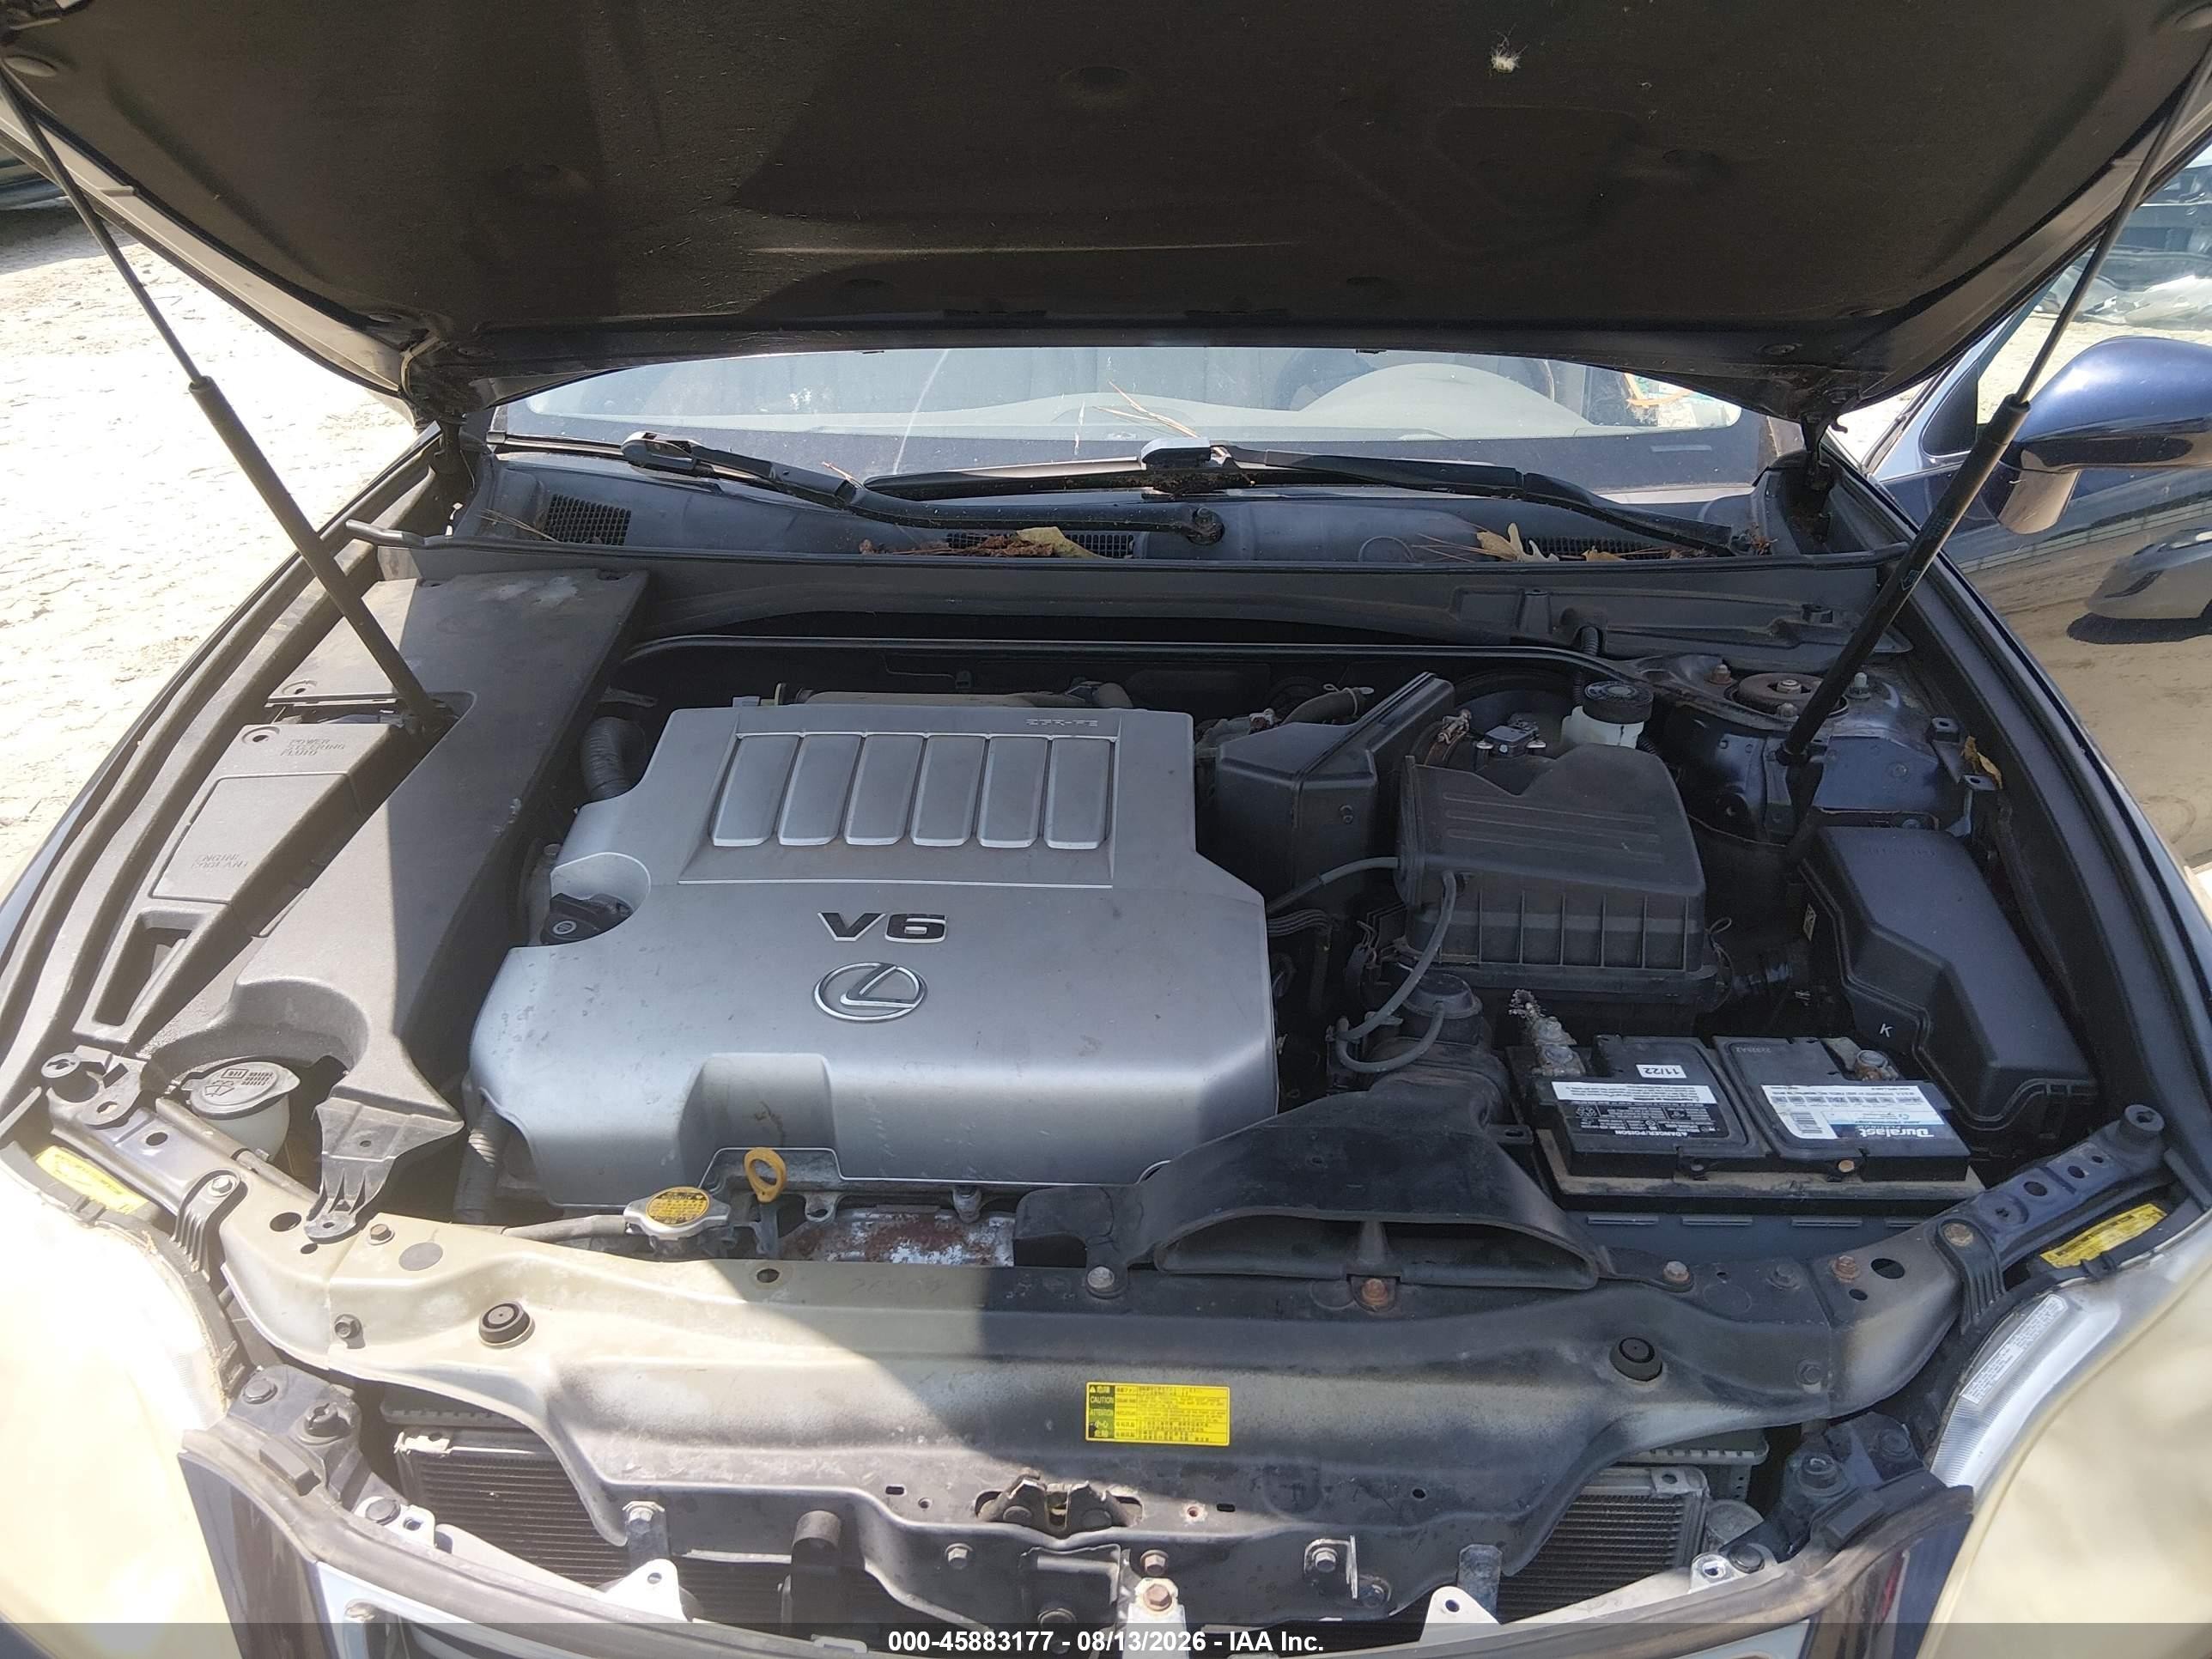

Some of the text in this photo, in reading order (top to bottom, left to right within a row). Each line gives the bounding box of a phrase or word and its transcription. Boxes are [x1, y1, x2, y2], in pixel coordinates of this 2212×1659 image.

[280, 748, 318, 757] FLUID
[817, 912, 949, 944] V6
[1880, 1023, 1893, 1038] K
[1643, 1067, 1680, 1077] 11/22
[1859, 1127, 1935, 1138] Duralast
[1091, 1395, 1115, 1404] CAUTION
